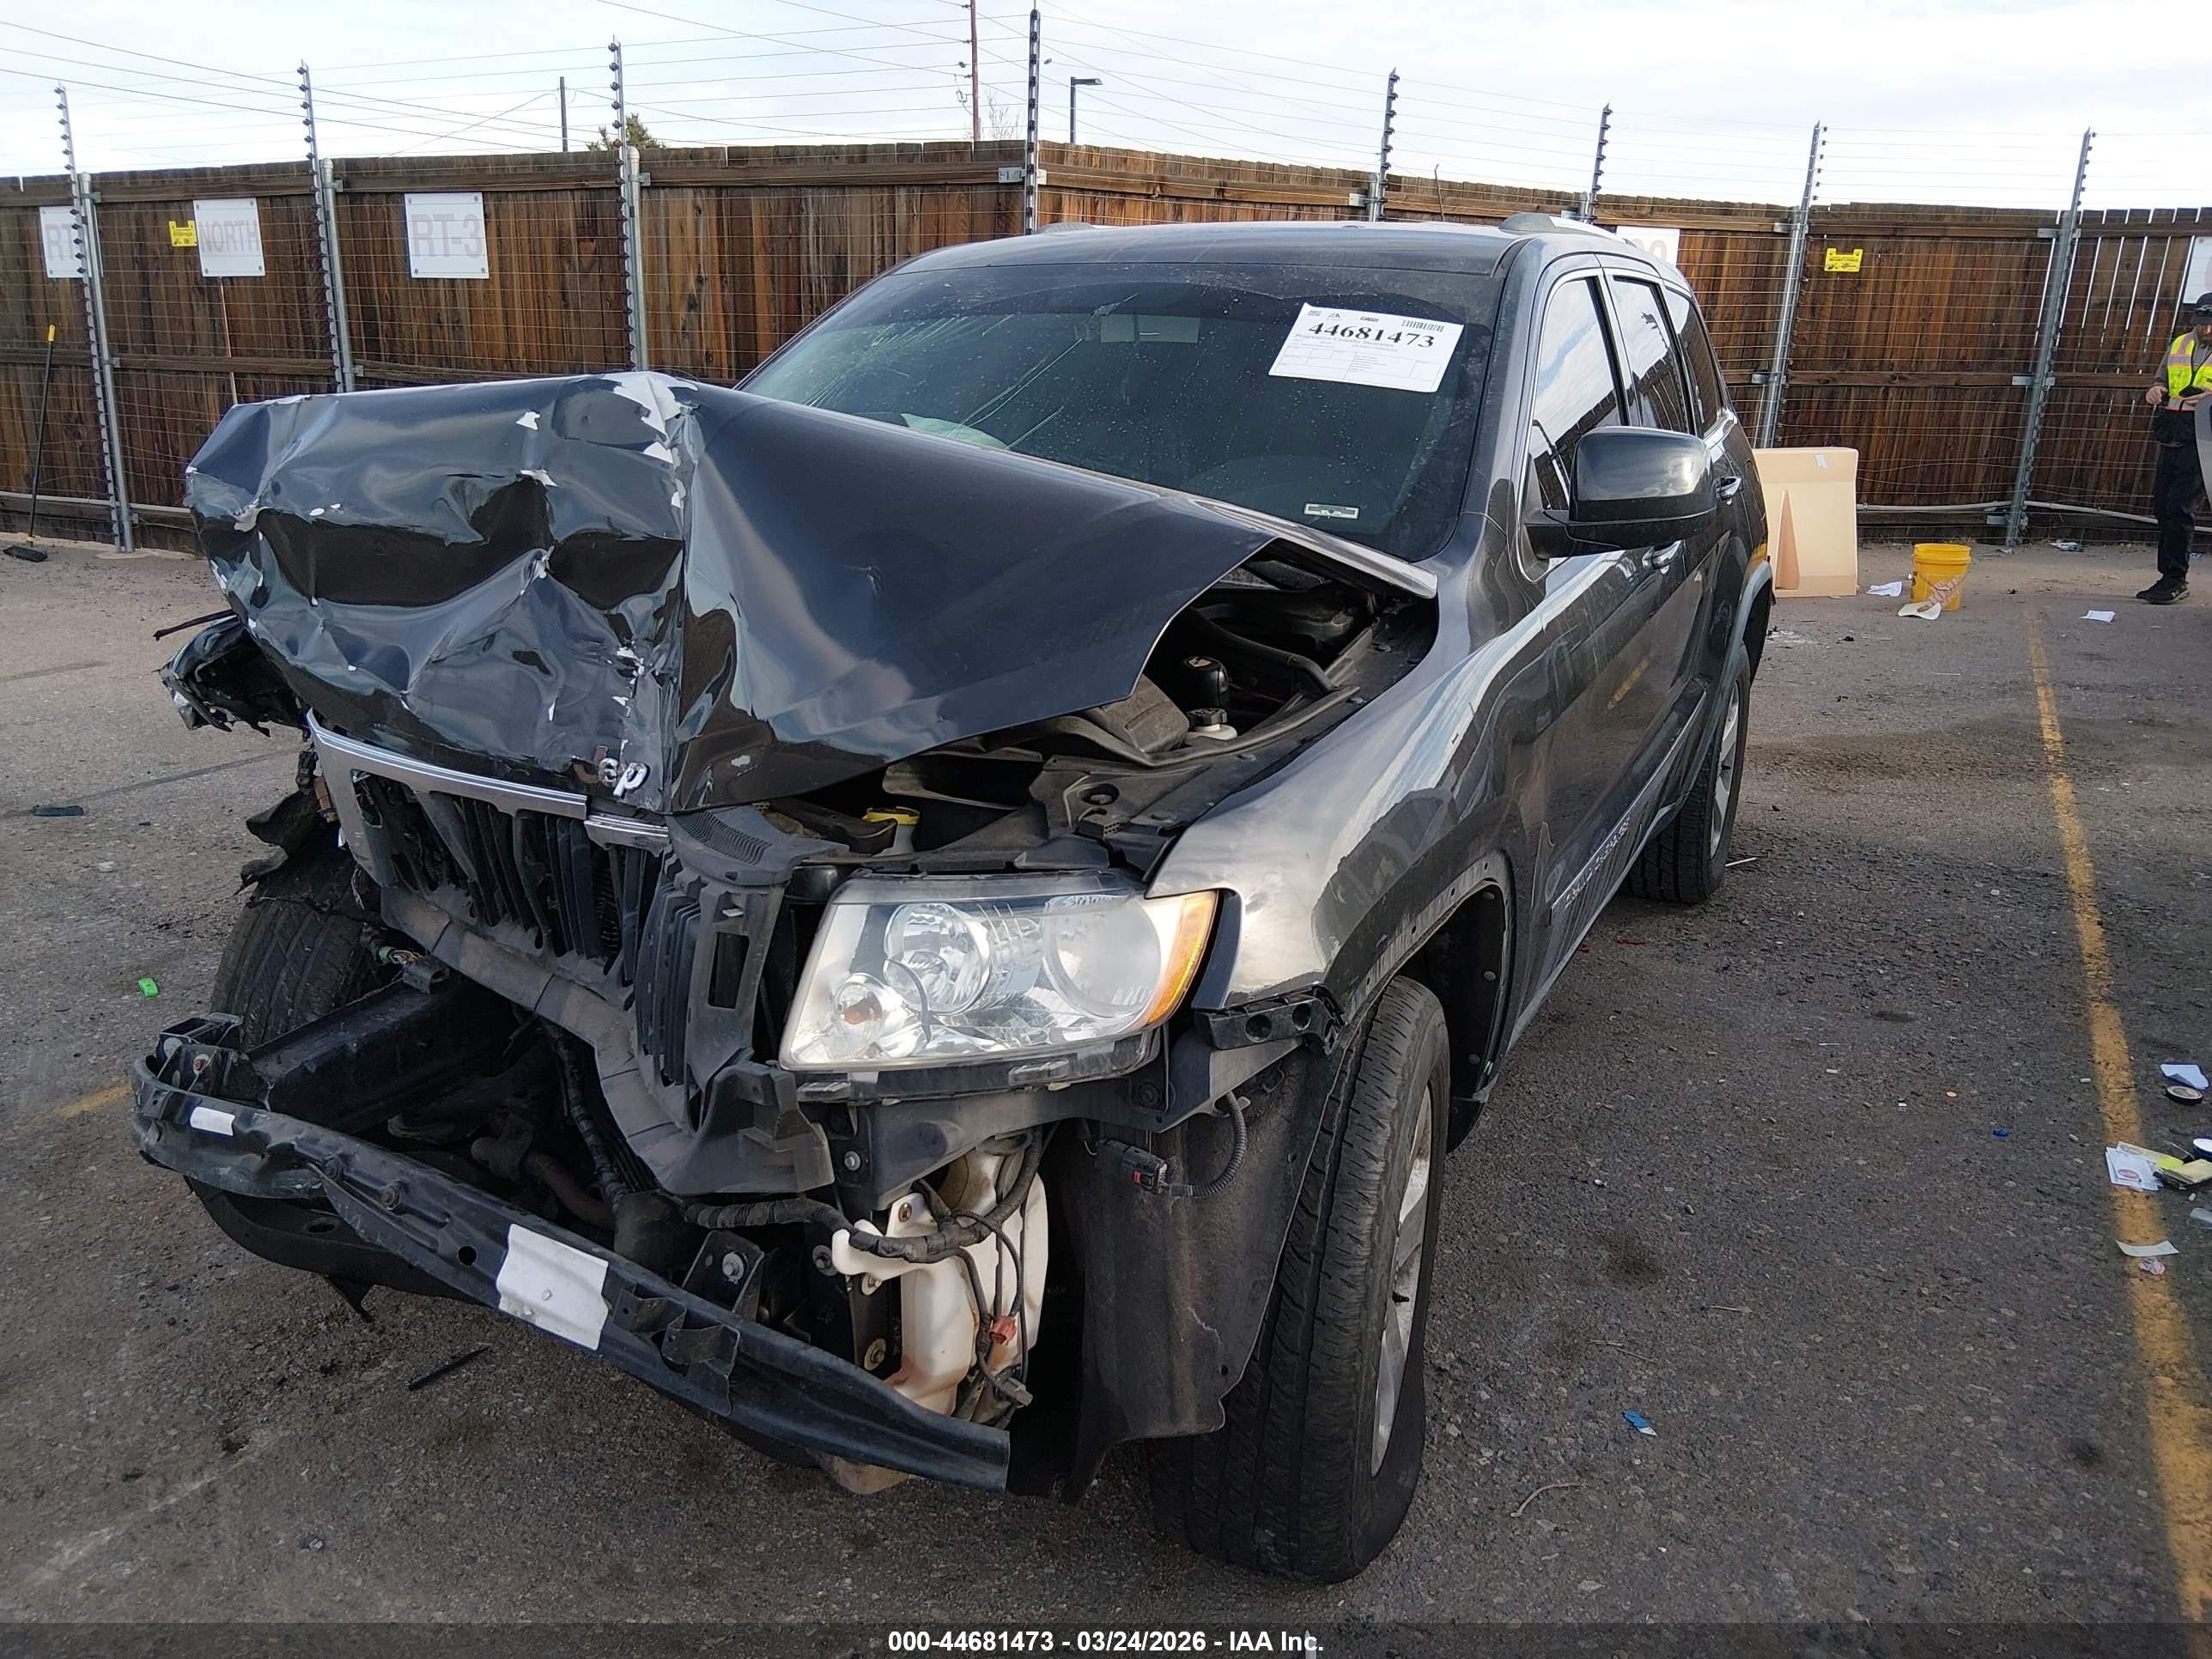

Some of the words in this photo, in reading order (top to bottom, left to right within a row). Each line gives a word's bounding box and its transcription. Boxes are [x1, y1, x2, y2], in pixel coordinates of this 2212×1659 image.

[198, 219, 260, 252] NORTH
[411, 213, 483, 258] RT-3
[1308, 322, 1436, 348] 44681473
